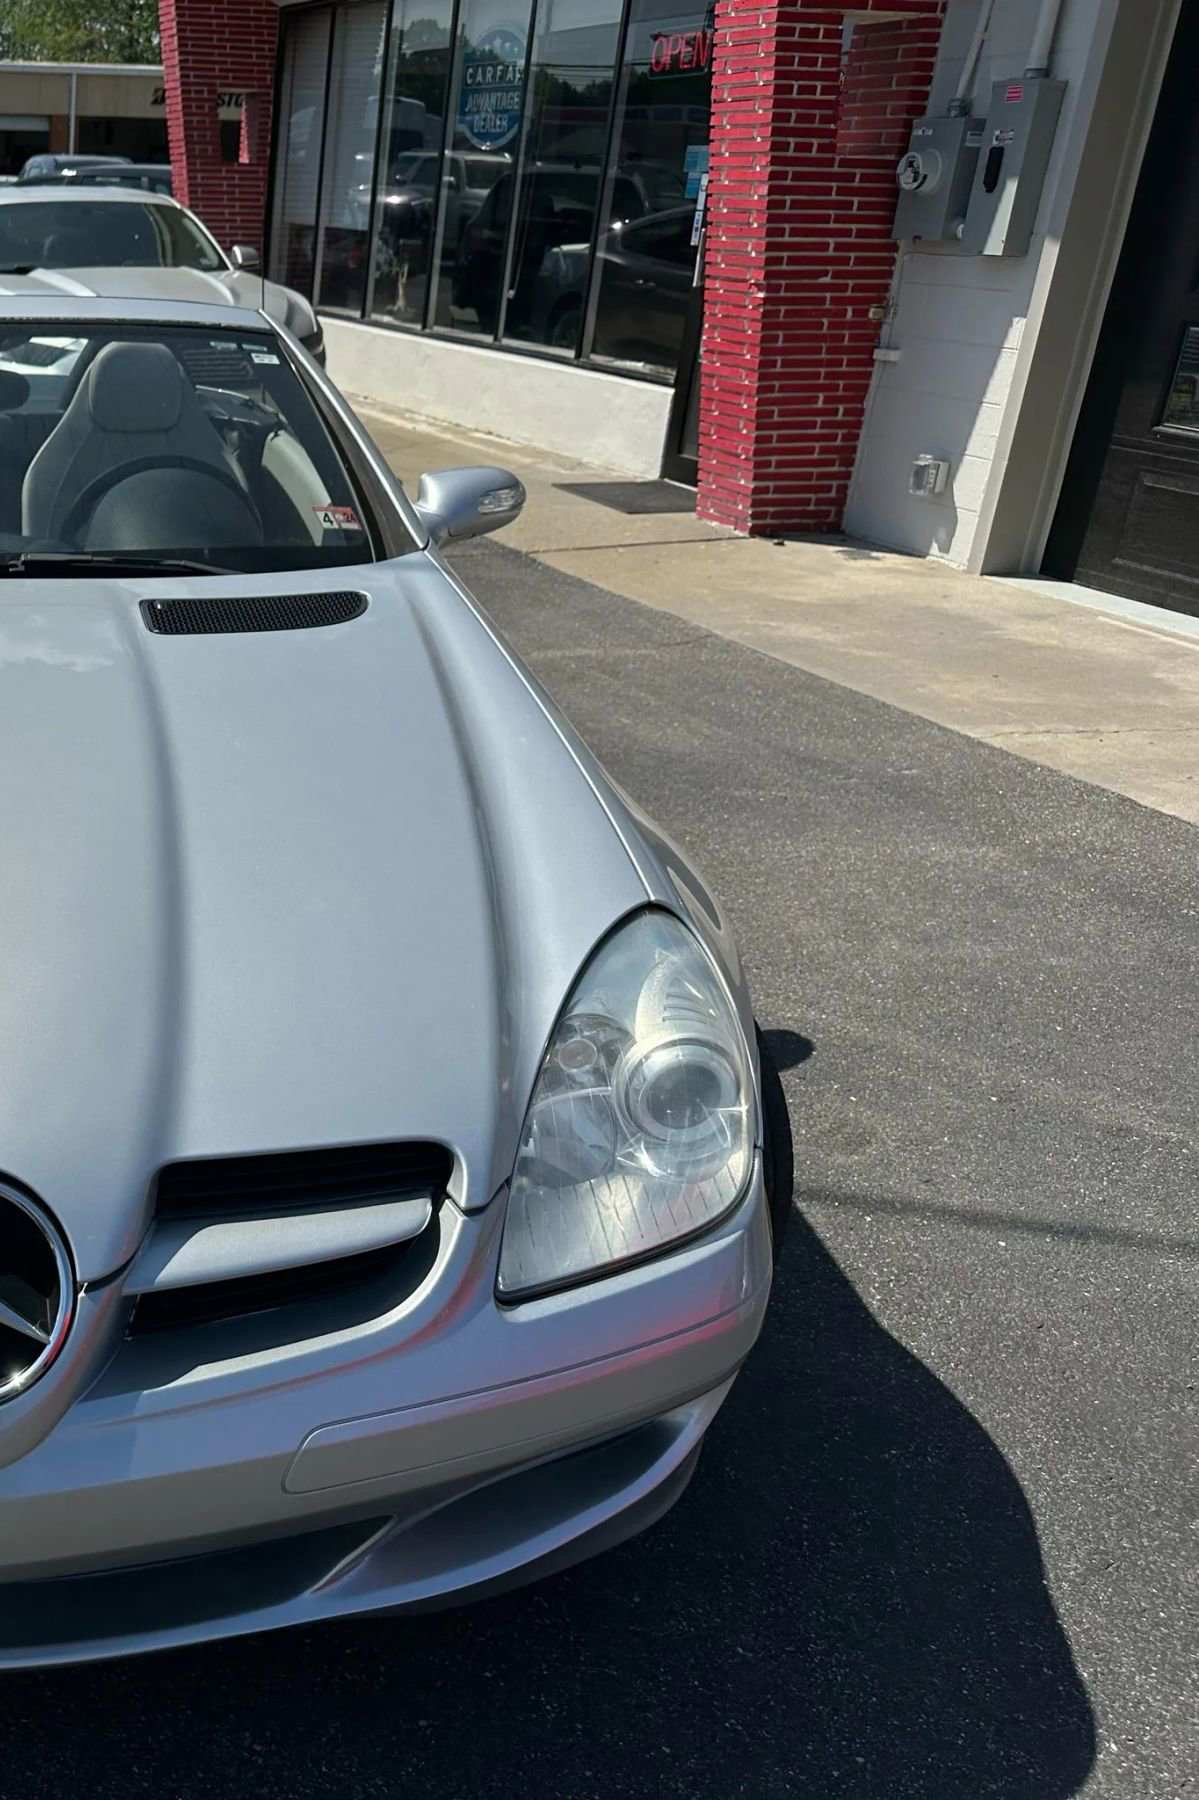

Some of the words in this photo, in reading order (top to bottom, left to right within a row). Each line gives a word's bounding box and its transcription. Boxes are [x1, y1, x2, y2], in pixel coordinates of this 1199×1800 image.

[652, 31, 709, 72] OPEN
[466, 91, 520, 112] ADVANTAGE
[473, 114, 509, 133] DEALER
[323, 512, 334, 526] 4
